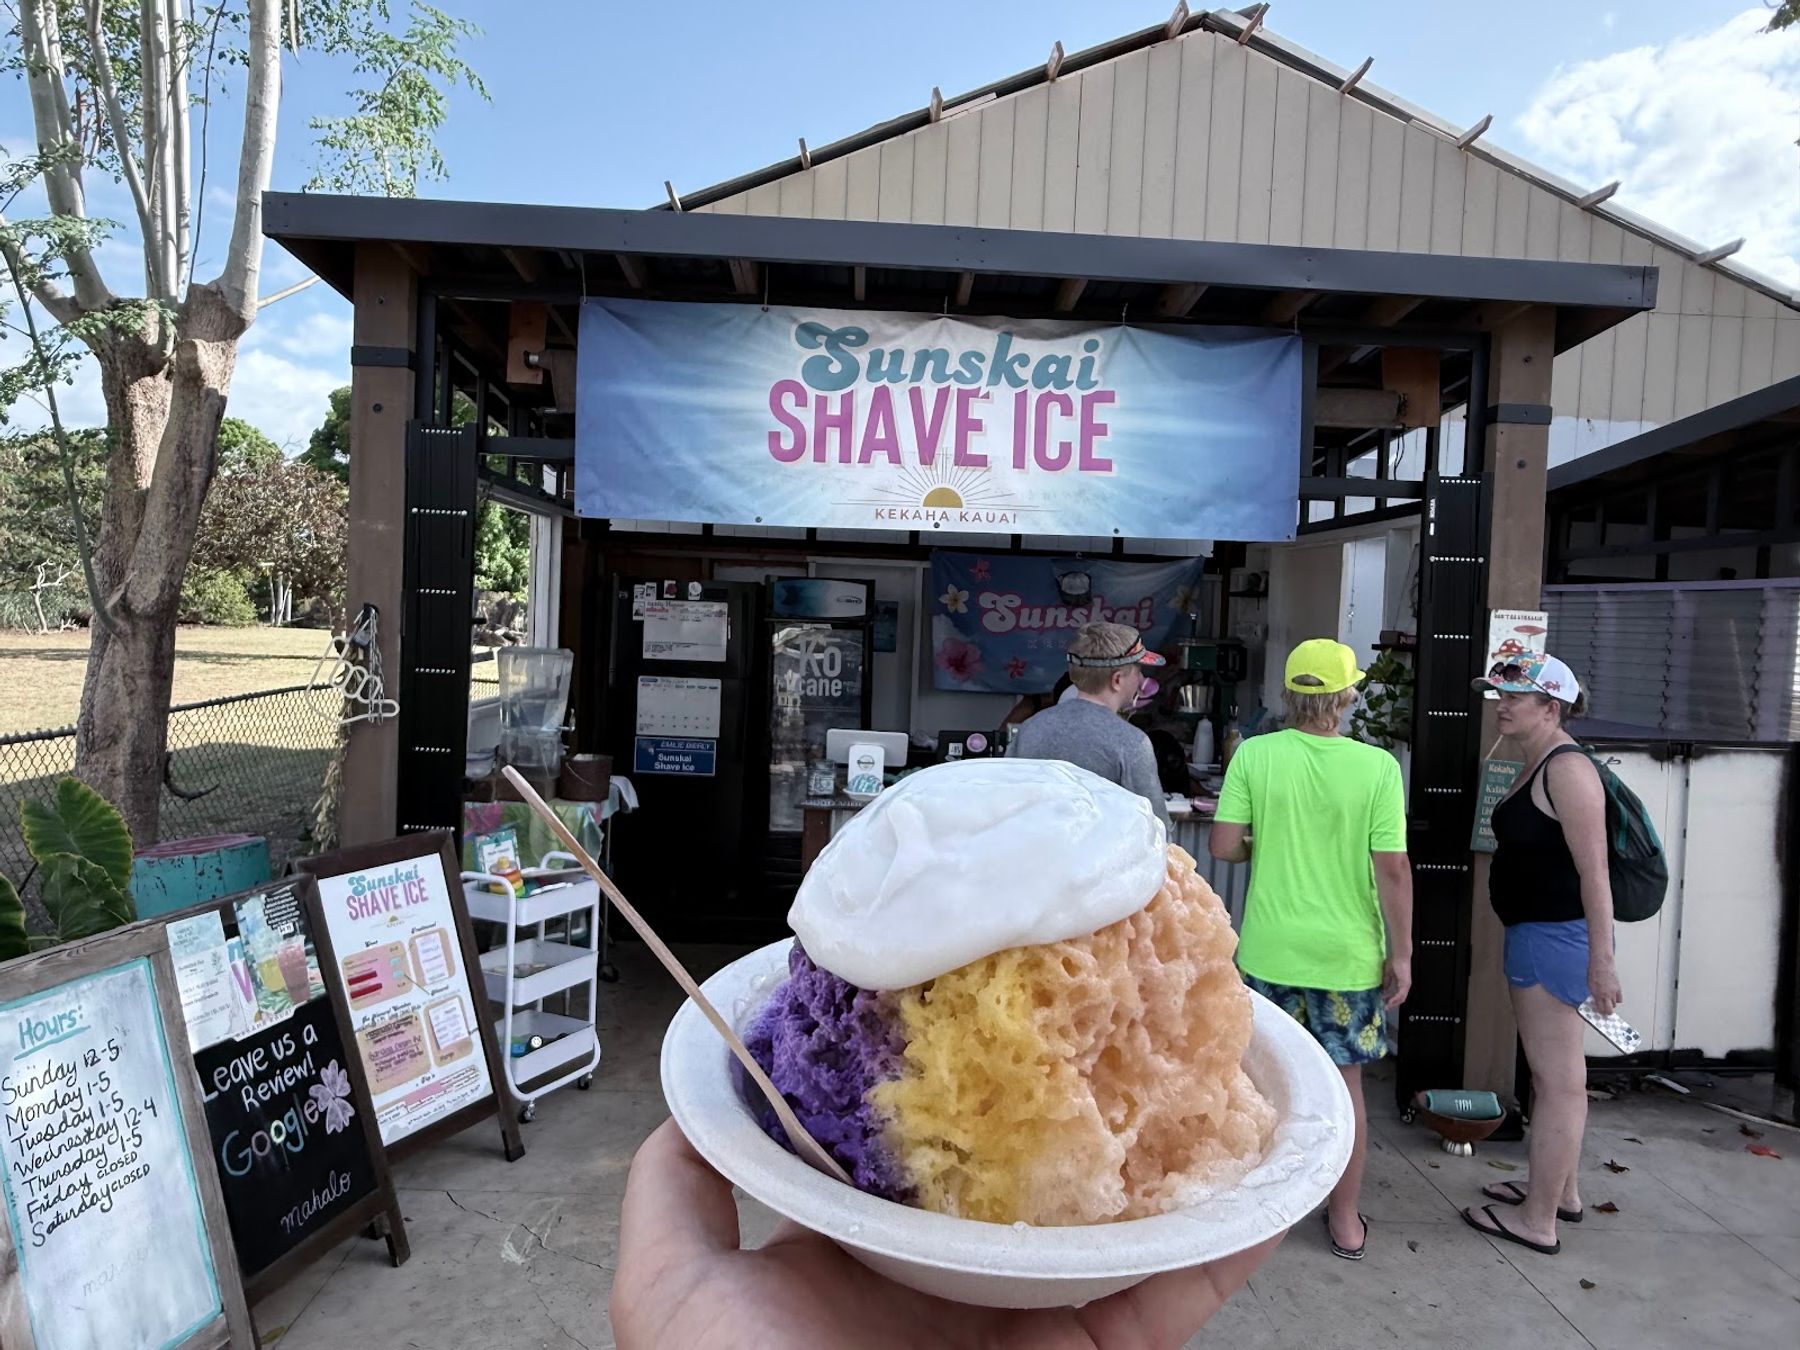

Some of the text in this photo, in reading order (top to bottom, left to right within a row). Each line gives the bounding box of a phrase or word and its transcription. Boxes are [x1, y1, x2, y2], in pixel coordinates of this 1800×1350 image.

[796, 321, 1102, 394] Sunskai
[767, 380, 1118, 473] SHAVE ICE
[875, 508, 1017, 525] KEKAHA KAUAI
[977, 591, 1154, 633] Sunskai
[346, 877, 430, 921] SHAVE ICE
[347, 864, 419, 897] Sunskai
[18, 1004, 84, 1049] Hours:
[1, 1058, 78, 1106] Sunday
[202, 1024, 318, 1102] Leave us a
[240, 1051, 317, 1112] Review!
[5, 1070, 111, 1136] Monday 1-5
[11, 1090, 124, 1157] Tuesday 1-5
[221, 1092, 320, 1176] Google
[21, 1143, 108, 1198] Thursday
[26, 1172, 93, 1224] Friday
[32, 1163, 151, 1248] Saturday CLOSED
